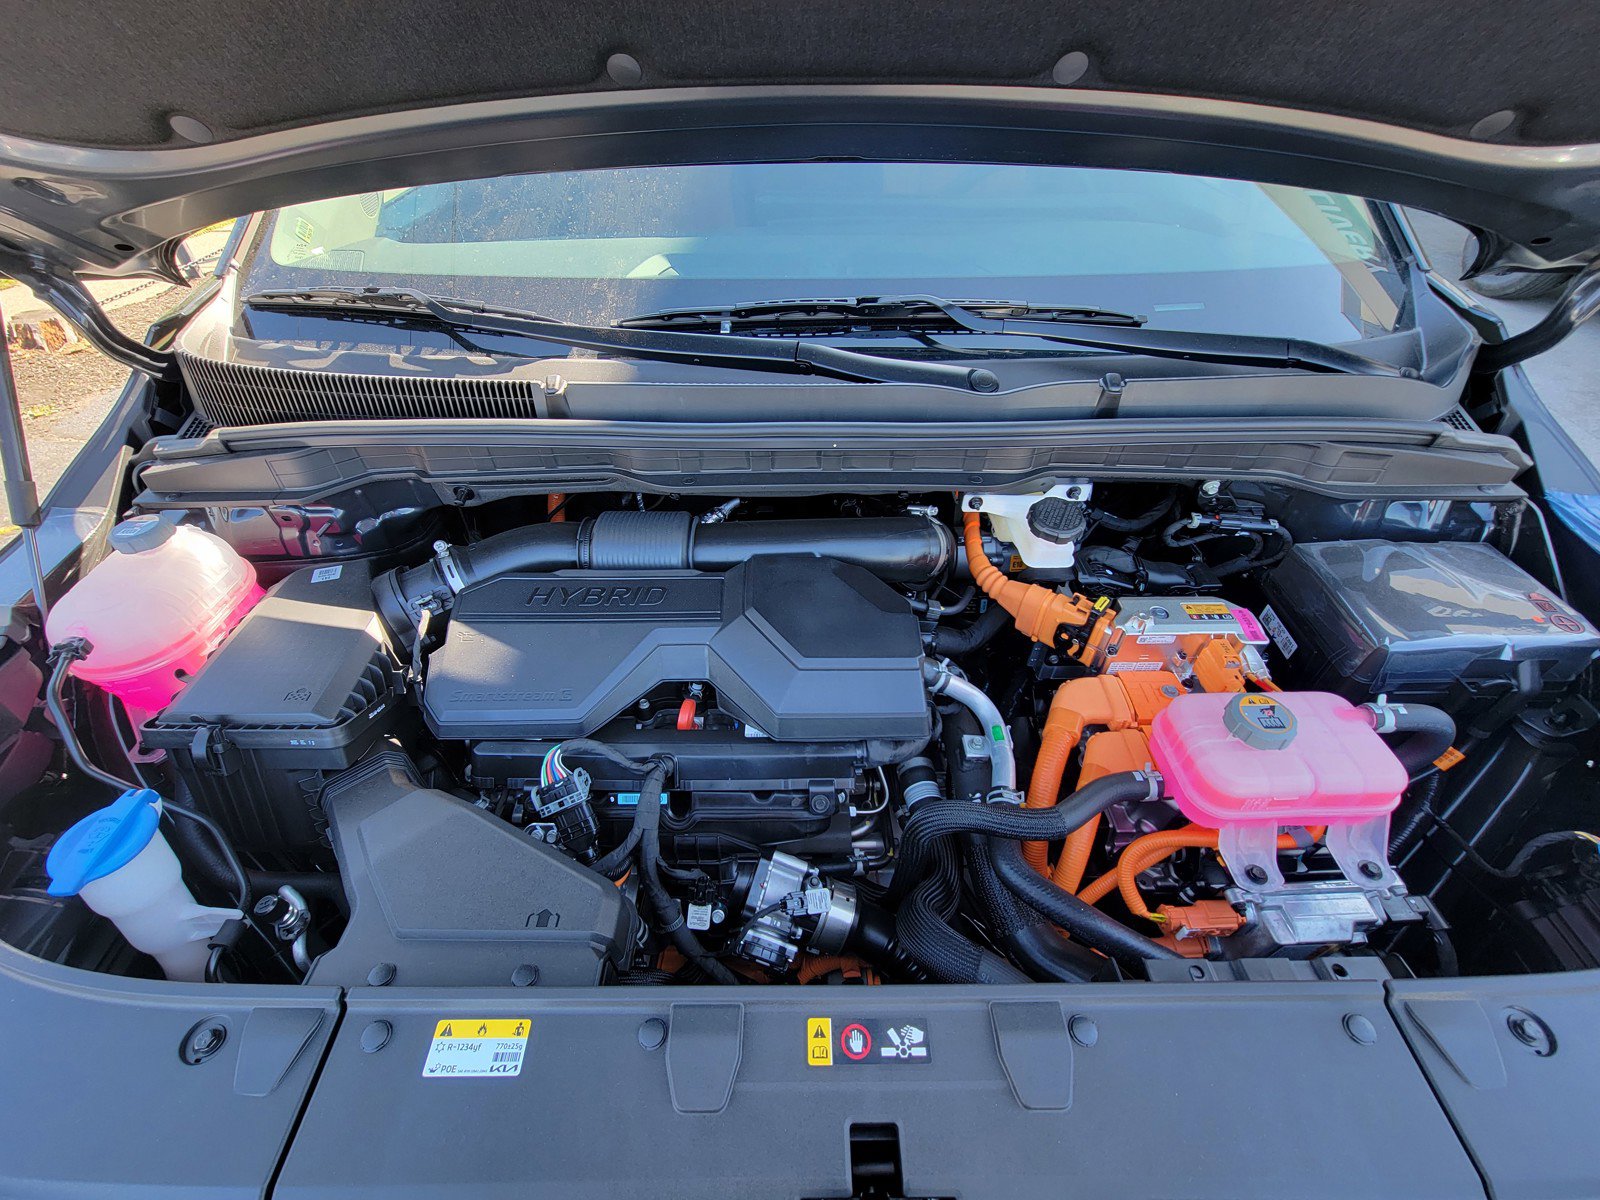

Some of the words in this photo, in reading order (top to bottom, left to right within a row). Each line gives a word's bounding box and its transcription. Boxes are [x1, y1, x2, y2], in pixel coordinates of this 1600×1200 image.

[524, 586, 668, 607] HYBRID
[450, 689, 555, 703] Smartstream
[558, 688, 573, 702] G
[447, 1043, 483, 1052] R-1234yf
[495, 1043, 523, 1051] 770±25g
[440, 1065, 457, 1073] POE
[489, 1064, 519, 1073] KIA
